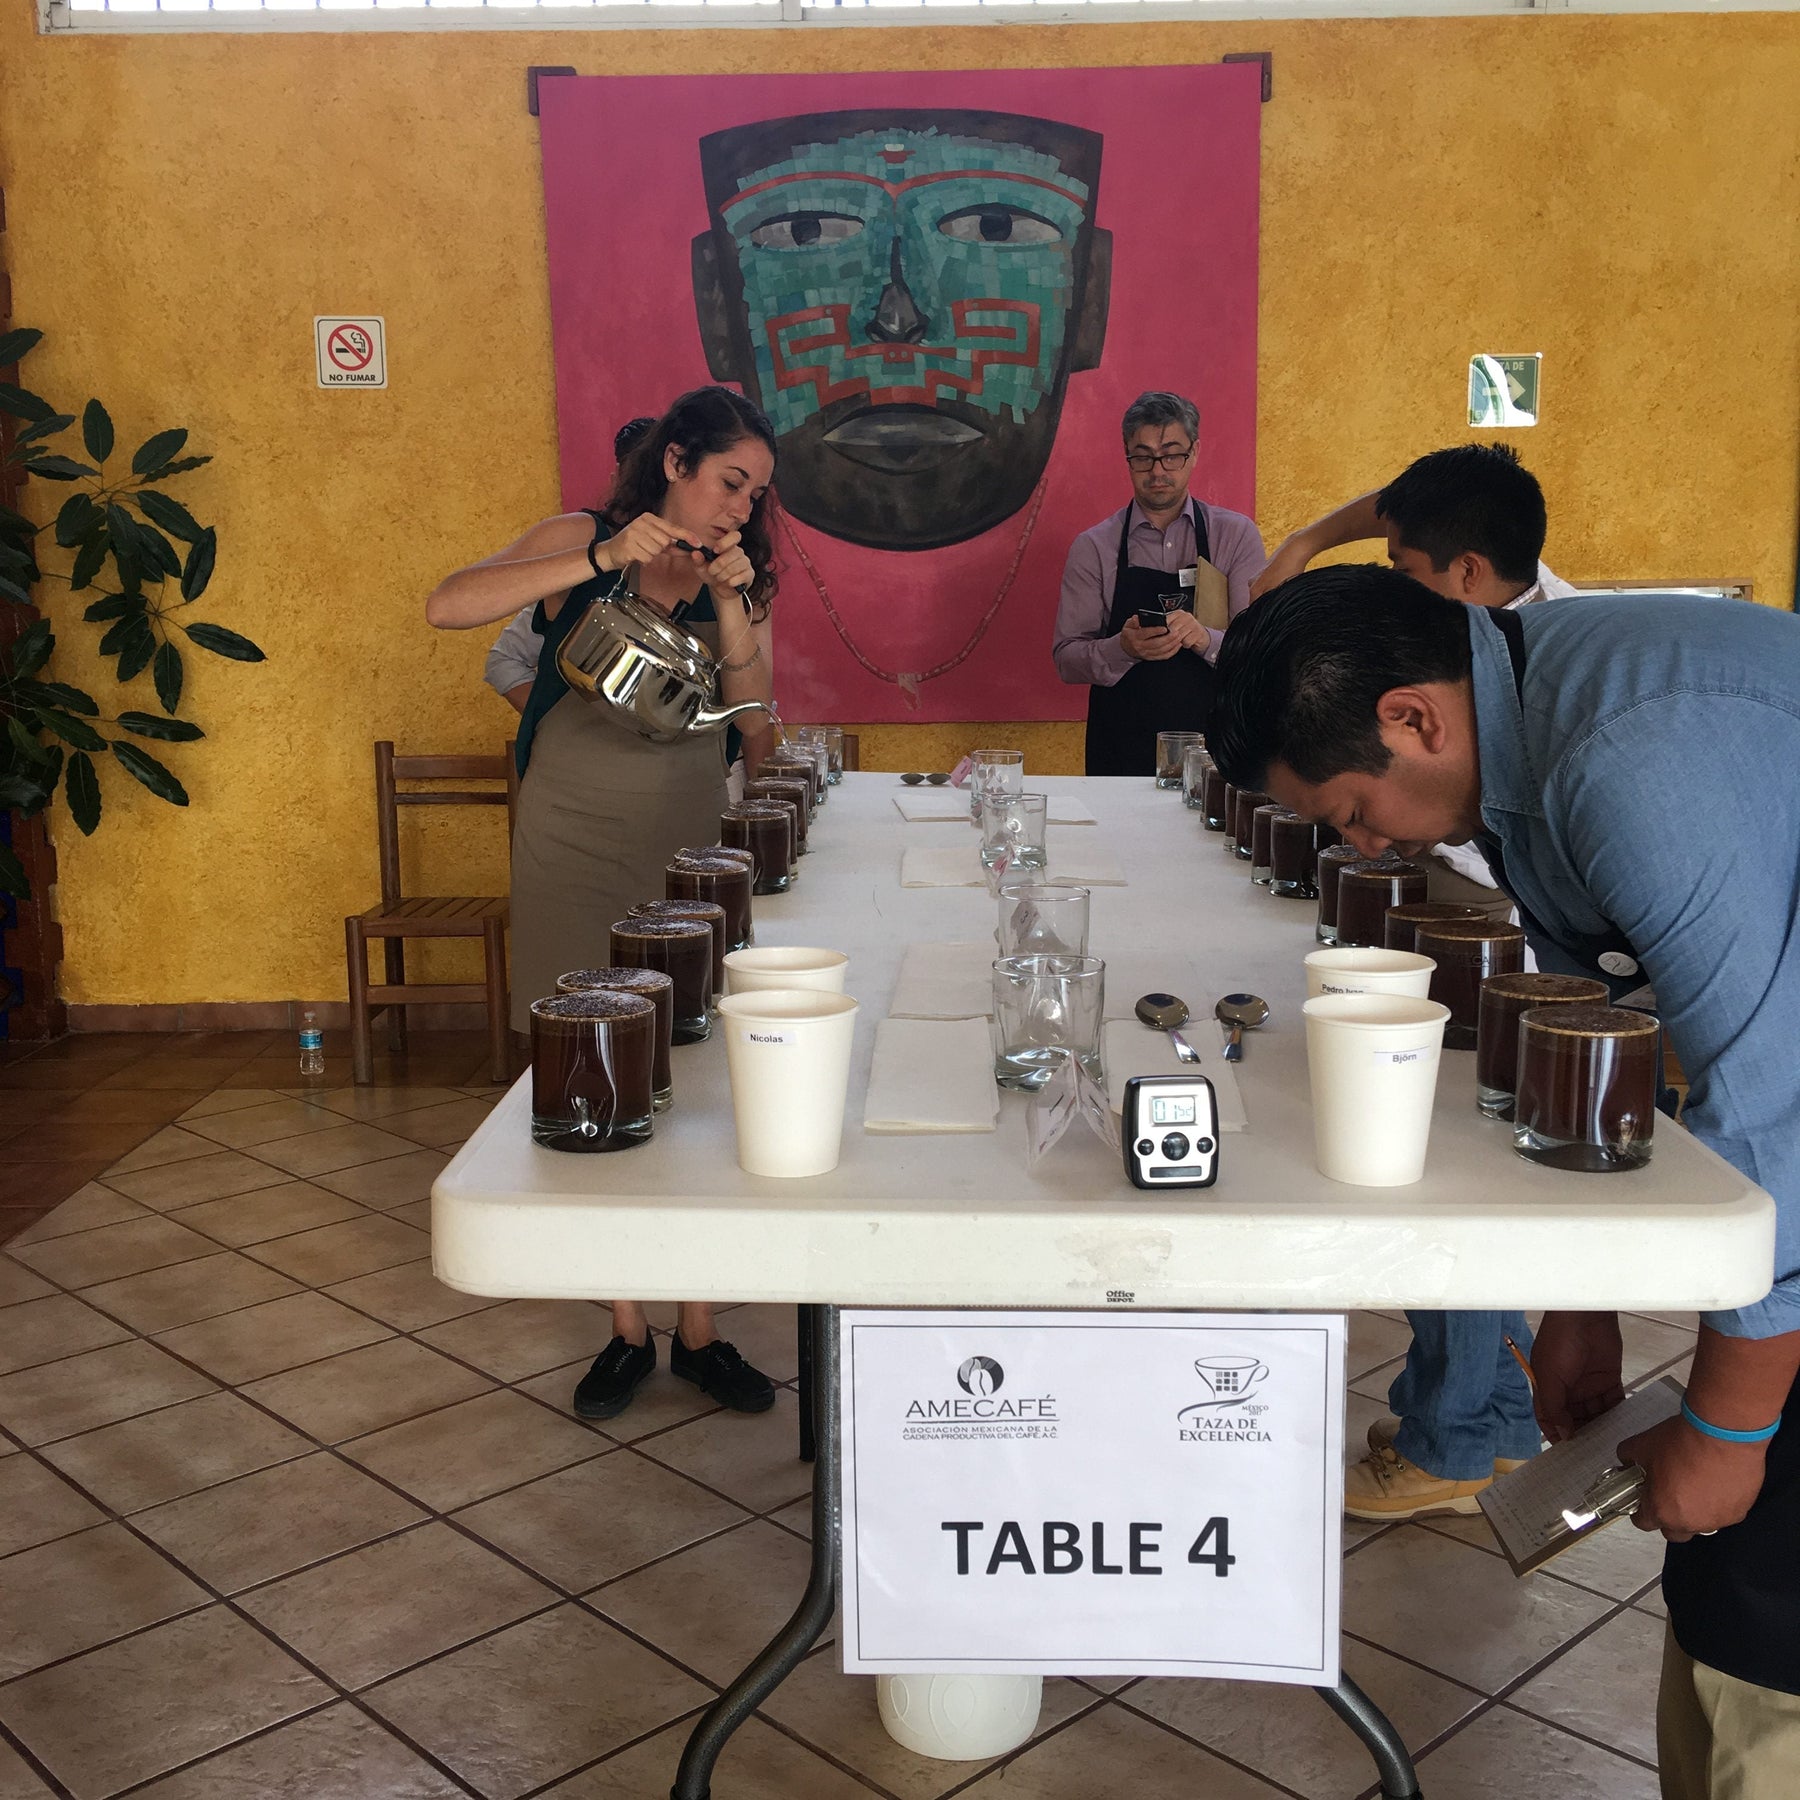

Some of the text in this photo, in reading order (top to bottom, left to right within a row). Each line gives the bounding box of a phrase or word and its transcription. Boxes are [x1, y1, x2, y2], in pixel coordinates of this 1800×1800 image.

[1512, 361, 1525, 371] DE
[329, 374, 376, 382] NO FUMAR
[1321, 983, 1344, 994] Pedro
[750, 1033, 783, 1043] Nicolas
[1392, 1053, 1417, 1065] Björn
[1106, 1290, 1135, 1298] Office
[905, 1394, 1057, 1419] AMECAFÉ
[1192, 1416, 1258, 1430] TAZA DE
[902, 1425, 969, 1434] ASOCIACIÓN
[971, 1425, 1024, 1433] MEXICANA
[1027, 1425, 1041, 1433] DE
[902, 1433, 940, 1441] CADENA
[997, 1432, 1014, 1440] DEL
[1179, 1429, 1272, 1442] EXCELENCIA
[941, 1516, 1237, 1578] TABLE 4
